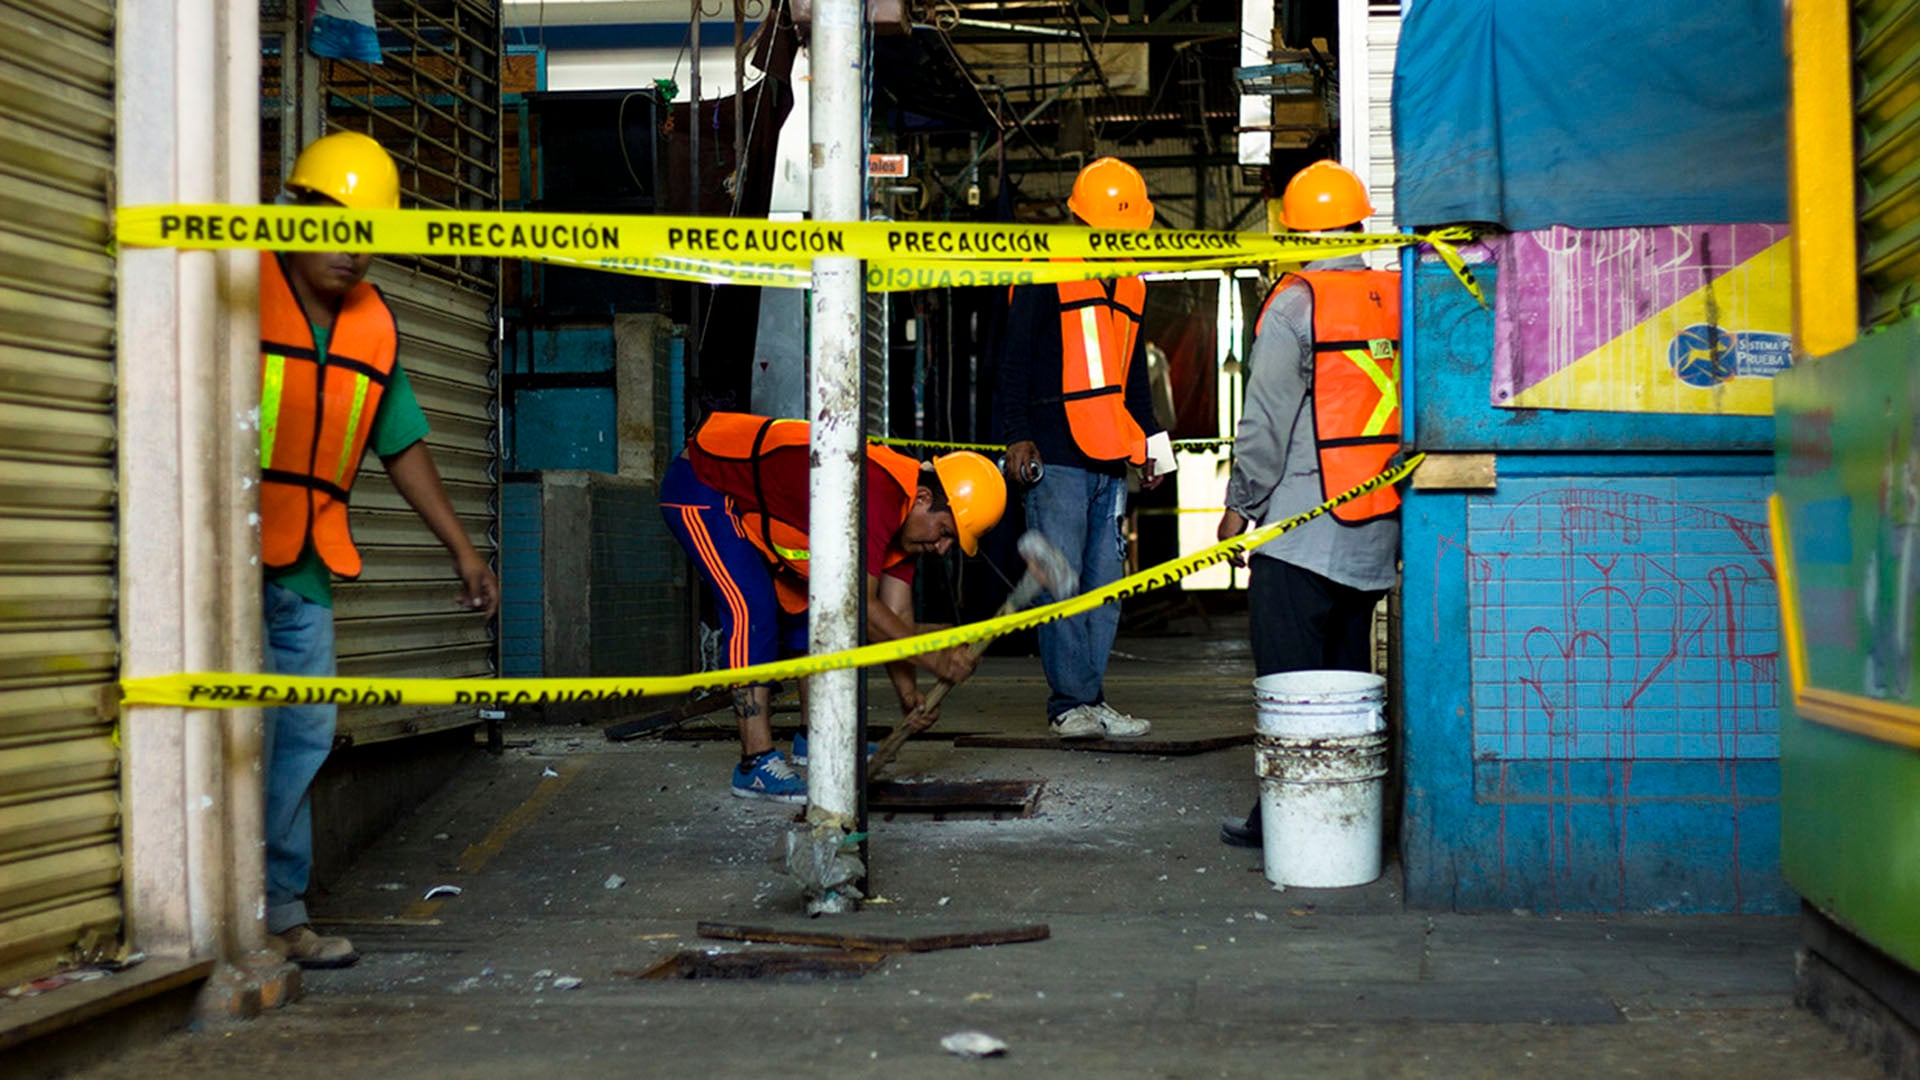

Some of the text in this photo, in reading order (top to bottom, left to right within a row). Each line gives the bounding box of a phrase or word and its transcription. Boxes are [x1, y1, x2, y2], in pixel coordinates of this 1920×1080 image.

[868, 159, 896, 172] ales
[160, 214, 374, 244] PRECAUCIÓN
[427, 222, 620, 249] PRECAUCIÓN
[668, 226, 844, 252] PRECAUCIÓN
[888, 229, 1050, 252] PRECAUCIÓN
